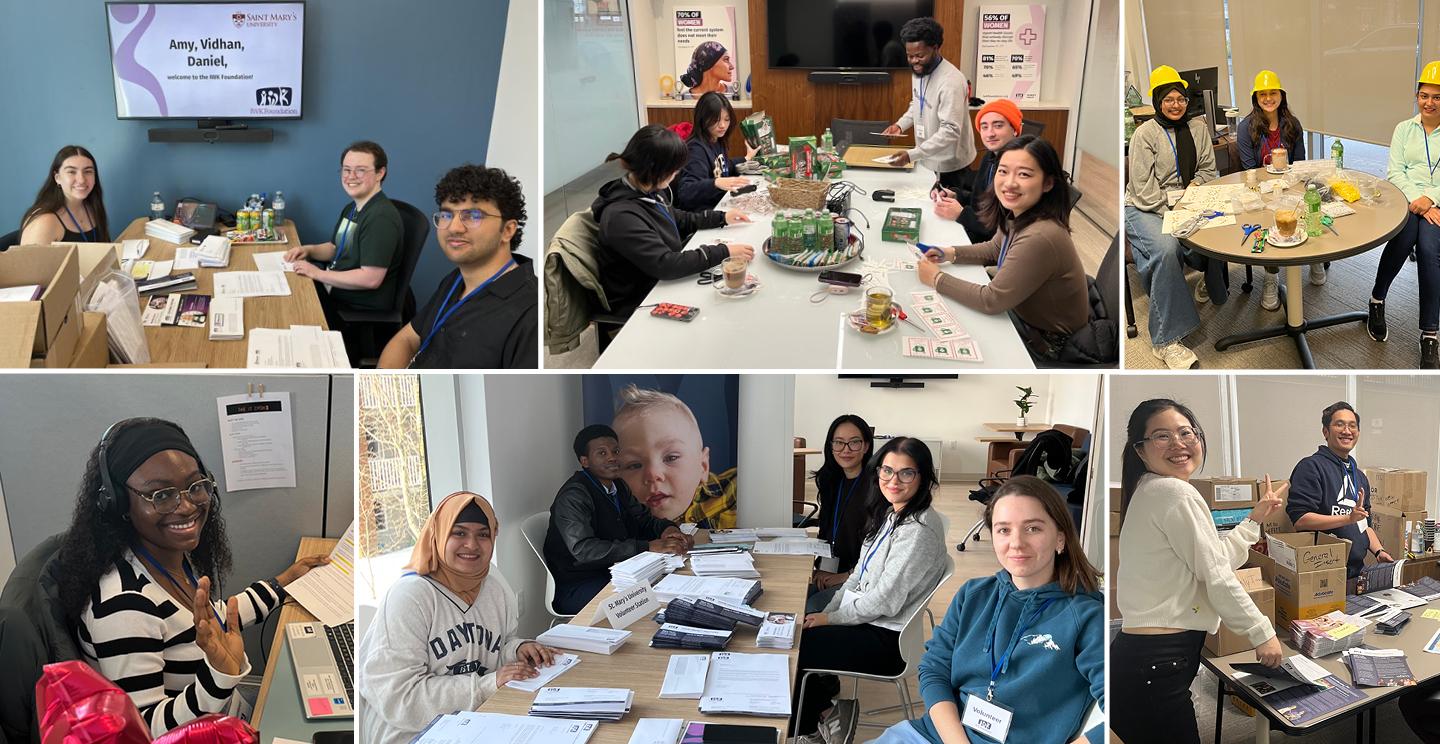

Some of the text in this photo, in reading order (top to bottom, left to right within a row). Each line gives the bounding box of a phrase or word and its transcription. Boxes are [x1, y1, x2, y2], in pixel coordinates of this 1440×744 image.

[246, 12, 297, 22] SAINT MARY'S
[169, 38, 245, 52] Amy, Vidhan,
[187, 56, 228, 68] Daniel,
[1303, 548, 1333, 564] General
[614, 596, 628, 606] Mary's
[627, 586, 647, 600] University
[615, 598, 649, 619] Volunteer Station
[973, 706, 1002, 724] Volunteer
